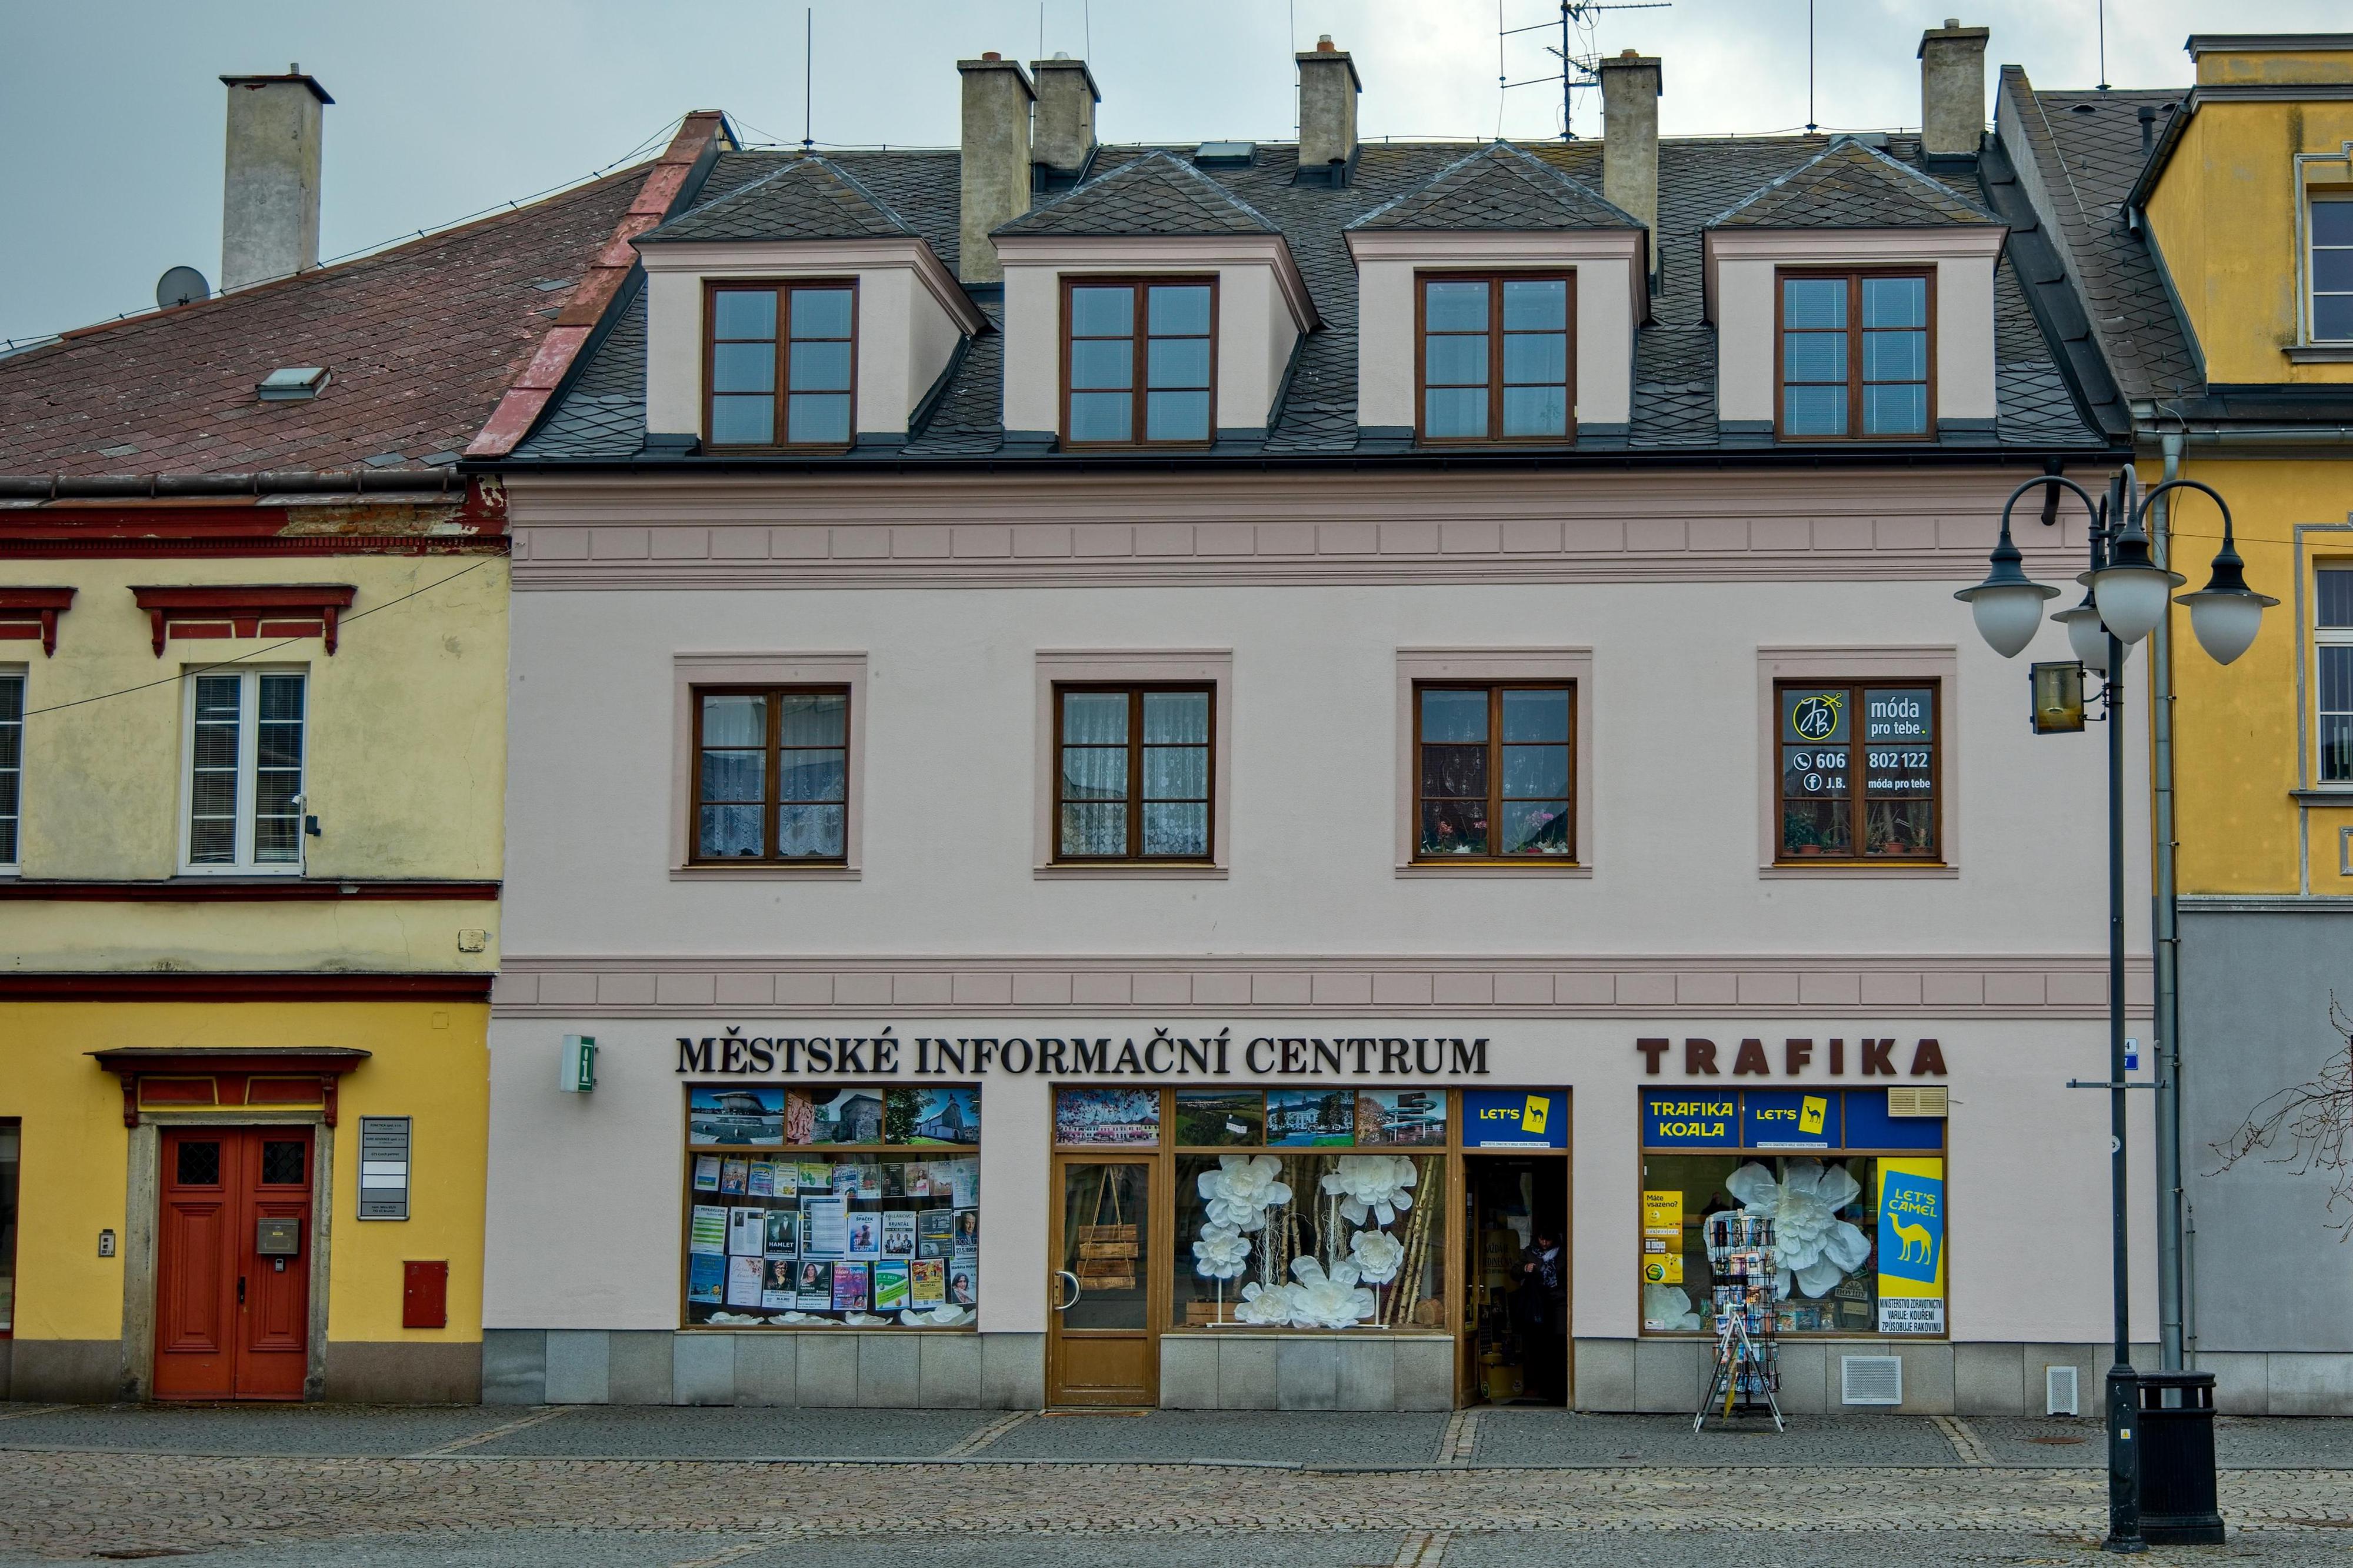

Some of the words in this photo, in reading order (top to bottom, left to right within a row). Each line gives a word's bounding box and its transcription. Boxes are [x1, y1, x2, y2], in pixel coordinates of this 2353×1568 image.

[1870, 696, 1919, 718] móda
[1871, 723, 1890, 737] pro
[1816, 753, 1846, 769] 606
[1869, 752, 1898, 768] 802
[1901, 752, 1928, 768] 122
[1826, 778, 1846, 789] J.B.
[1868, 778, 1892, 789] móda
[1895, 780, 1909, 790] pro
[1911, 778, 1931, 789] tebe
[675, 1026, 899, 1074] MĚSTSKÉ
[914, 1026, 1231, 1074] INFORMAČNÍ
[1245, 1037, 1491, 1074] CENTRUM
[1637, 1038, 1948, 1075] TRAFIKA
[1649, 1102, 1733, 1116] TRAFIKA
[1659, 1122, 1725, 1137] KOALA
[1888, 1199, 1938, 1217] CAMEL
[1879, 1299, 1909, 1309] MINISTERSTVO
[1910, 1297, 1942, 1309] ZDRAVOTNICTVÍ
[1888, 1310, 1908, 1320] VARUJE:
[1909, 1309, 1935, 1320] KOUŘENÍ
[1882, 1321, 1913, 1332] ZPŮSOBUJE
[1914, 1322, 1941, 1332] RAKOVINU
